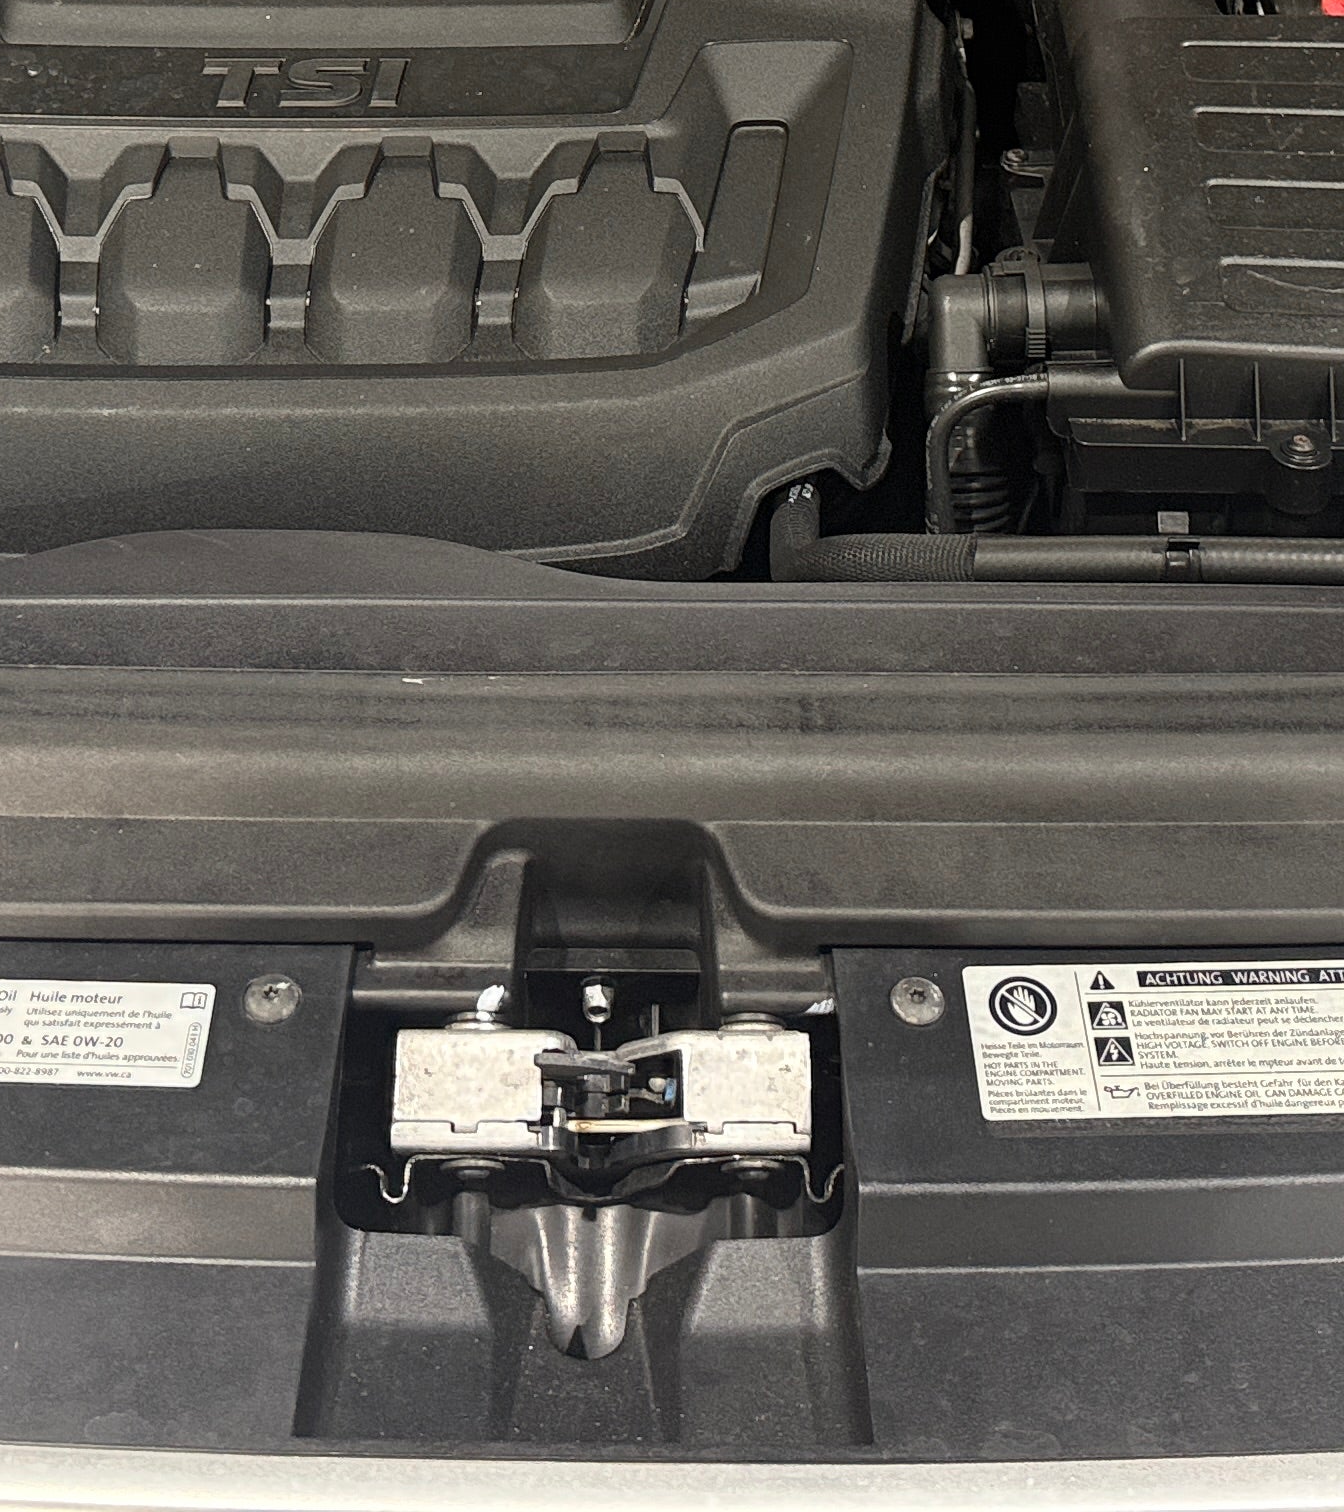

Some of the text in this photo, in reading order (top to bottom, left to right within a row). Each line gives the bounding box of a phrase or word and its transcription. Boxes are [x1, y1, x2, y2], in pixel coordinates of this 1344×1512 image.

[201, 56, 412, 108] TSI
[1145, 972, 1223, 985] ACHTUNG
[1231, 970, 1310, 984] WARNING
[30, 991, 67, 1003] Huile
[70, 993, 123, 1004] moteur
[26, 1008, 62, 1017] Utilisez
[65, 1010, 125, 1020] uniquement
[128, 1010, 140, 1018] de
[1180, 1008, 1198, 1016] FAN
[1201, 1008, 1222, 1016] MAY
[1225, 1007, 1253, 1015] START
[23, 1019, 40, 1028] qui
[42, 1019, 81, 1028] satisfait
[155, 1021, 161, 1029] à
[21, 1036, 32, 1045] &
[41, 1035, 69, 1046] SAE
[73, 1036, 124, 1048] 0W-20
[1136, 1041, 1163, 1049] HIGH
[1212, 1040, 1249, 1048] SWITCH
[1251, 1039, 1268, 1047] OFF
[1272, 1039, 1308, 1047] ENGINE
[16, 1050, 38, 1058] Pour
[61, 1051, 81, 1060] liste
[1140, 1061, 1170, 1069] Haute
[1214, 1059, 1246, 1067] arrêter
[1247, 1059, 1256, 1067] le
[1297, 1057, 1322, 1065] avant
[1325, 1057, 1336, 1065] de
[1144, 1082, 1159, 1090] Bei
[1222, 1080, 1257, 1088] besteht
[1260, 1079, 1293, 1088] Gefahr
[1297, 1078, 1311, 1086] für
[1146, 1092, 1203, 1100] OVERFILLED
[1205, 1091, 1242, 1099] ENGINE
[1244, 1090, 1261, 1098] OIL
[1264, 1089, 1286, 1097] CAN
[1289, 1088, 1332, 1097] DAMAGE
